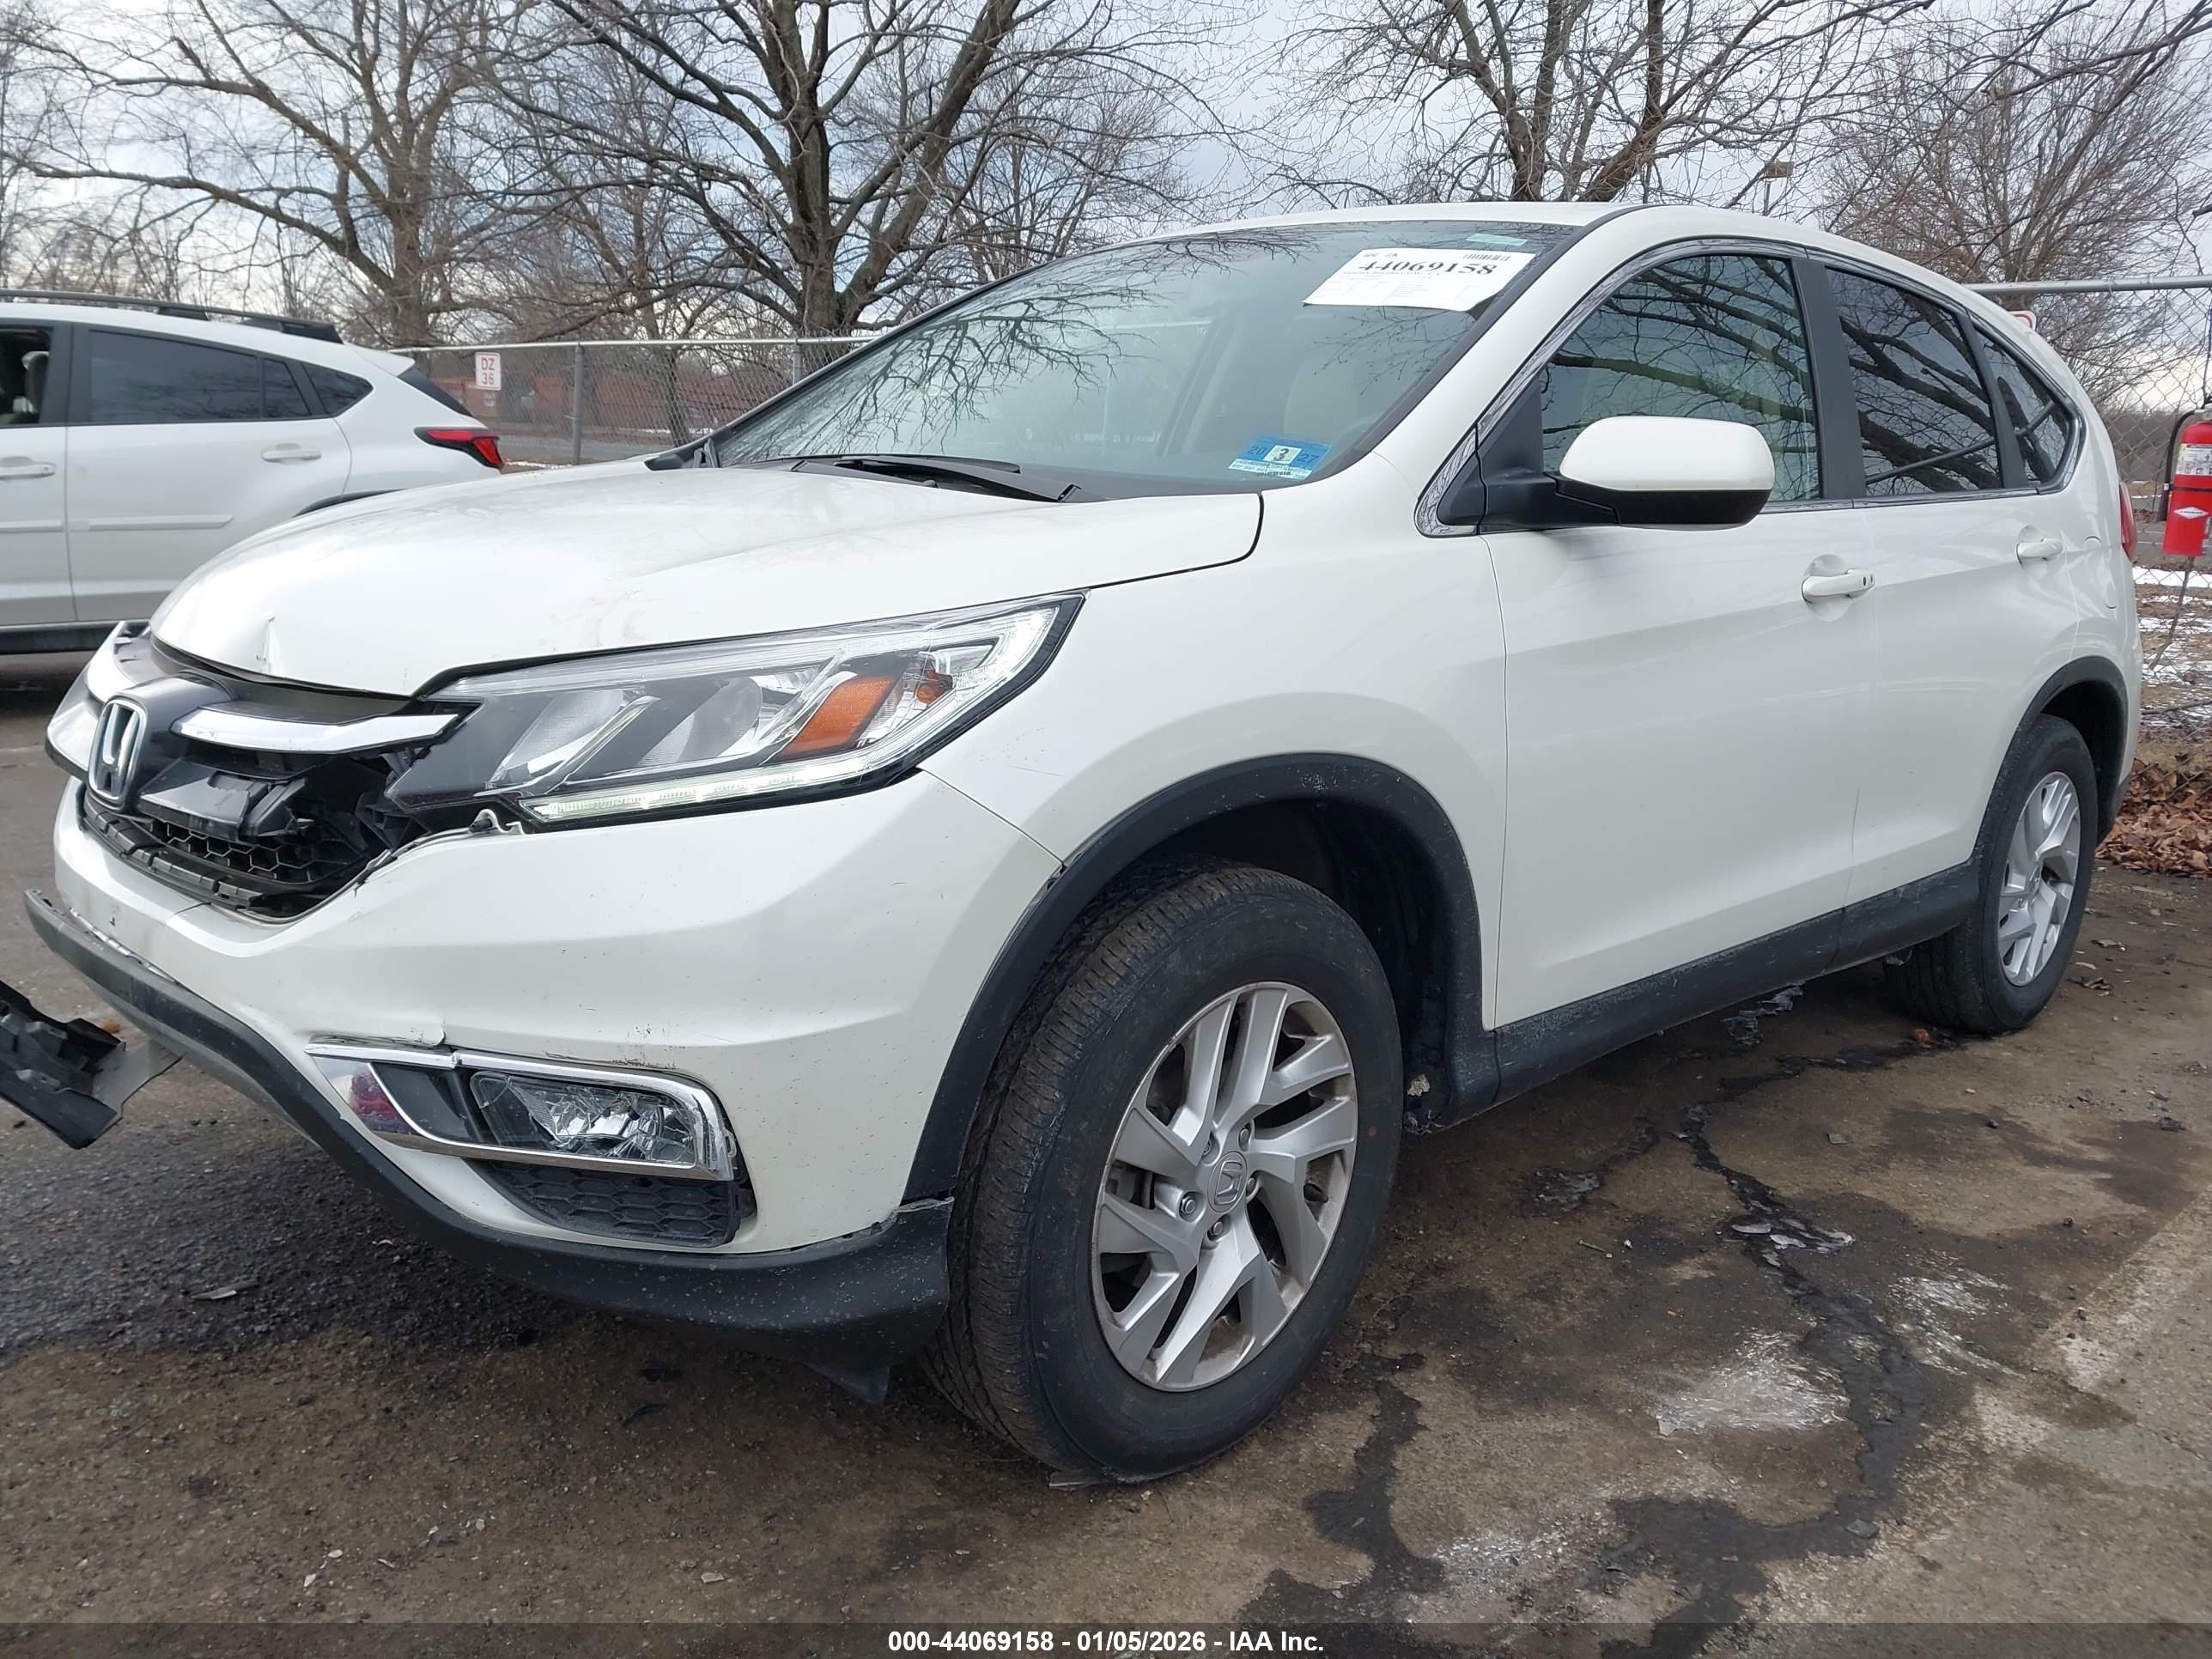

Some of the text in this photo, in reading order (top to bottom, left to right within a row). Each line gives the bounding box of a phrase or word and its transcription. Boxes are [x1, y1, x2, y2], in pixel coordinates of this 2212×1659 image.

[1358, 261, 1498, 276] 44069158
[481, 357, 495, 370] DZ
[482, 372, 495, 385] 36
[1247, 446, 1320, 464] 20 3 27
